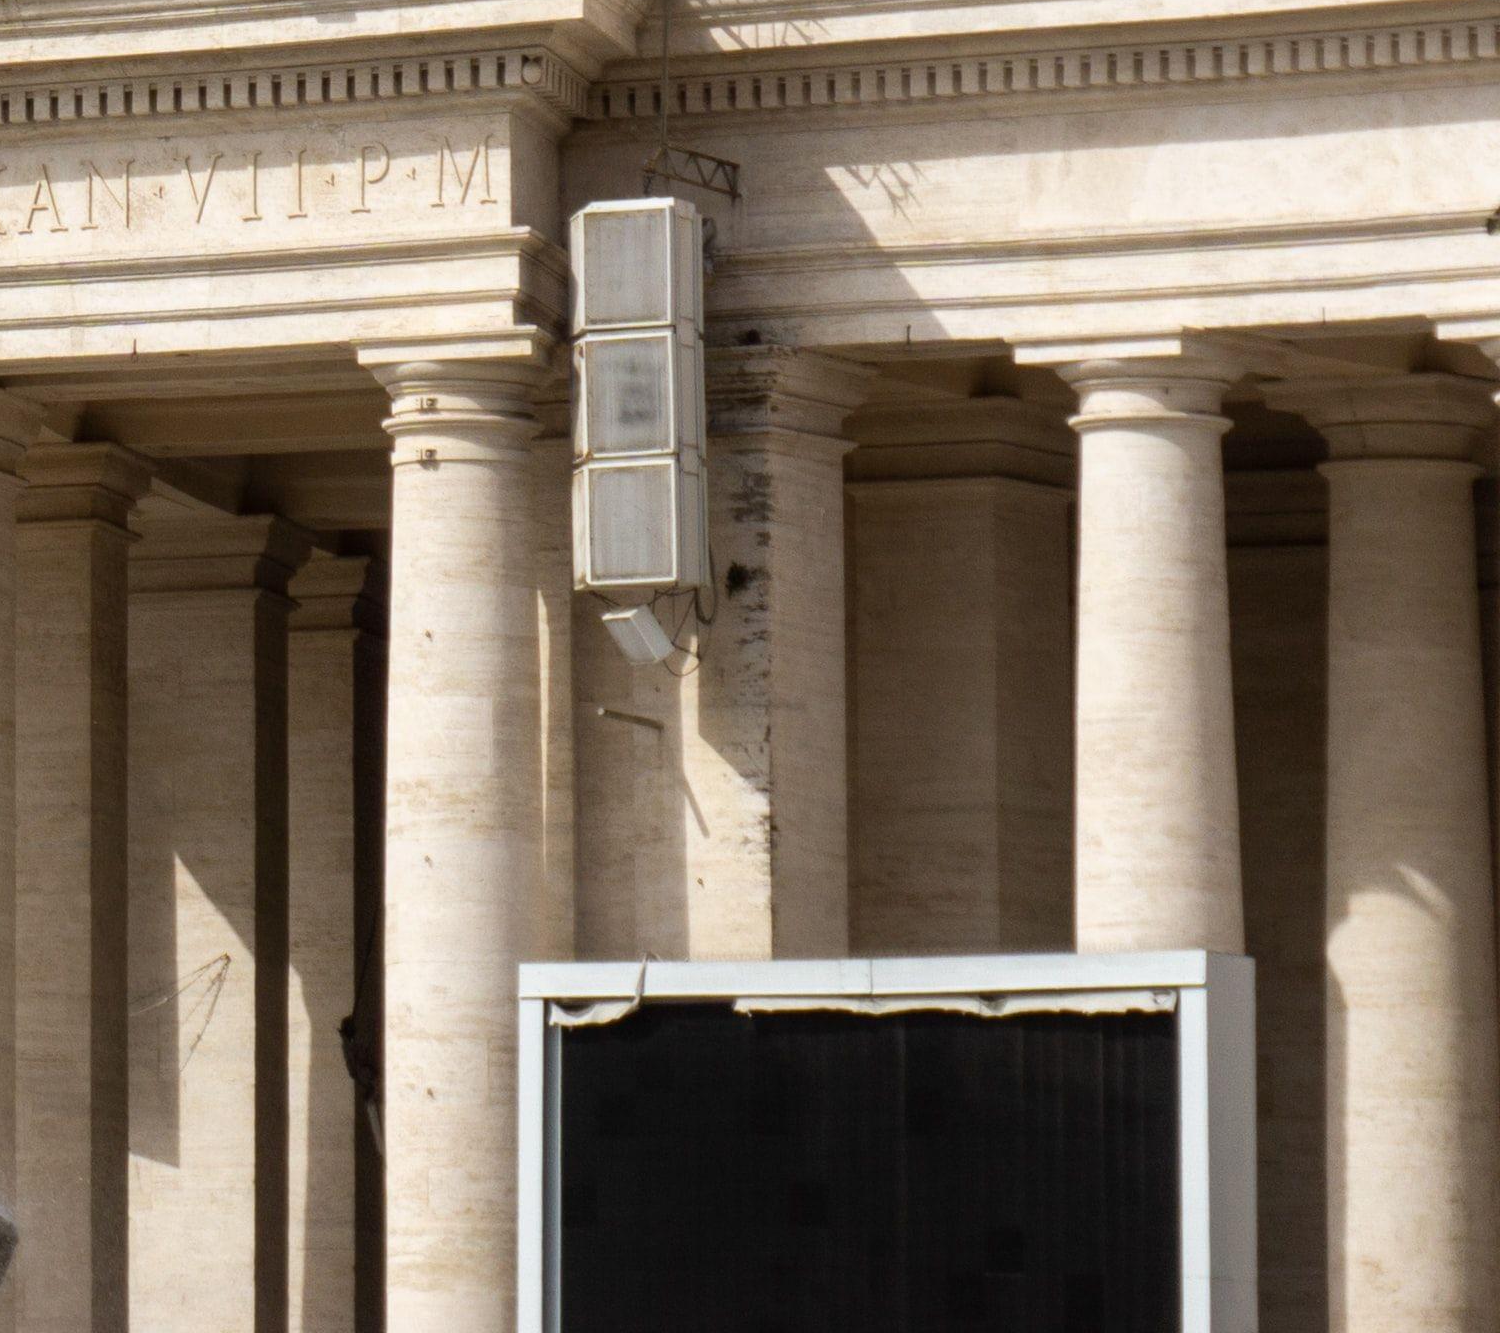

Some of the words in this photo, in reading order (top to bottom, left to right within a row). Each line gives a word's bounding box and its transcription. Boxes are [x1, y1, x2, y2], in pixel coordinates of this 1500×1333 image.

[172, 147, 309, 224] VII
[350, 144, 392, 215] P
[430, 134, 499, 209] M
